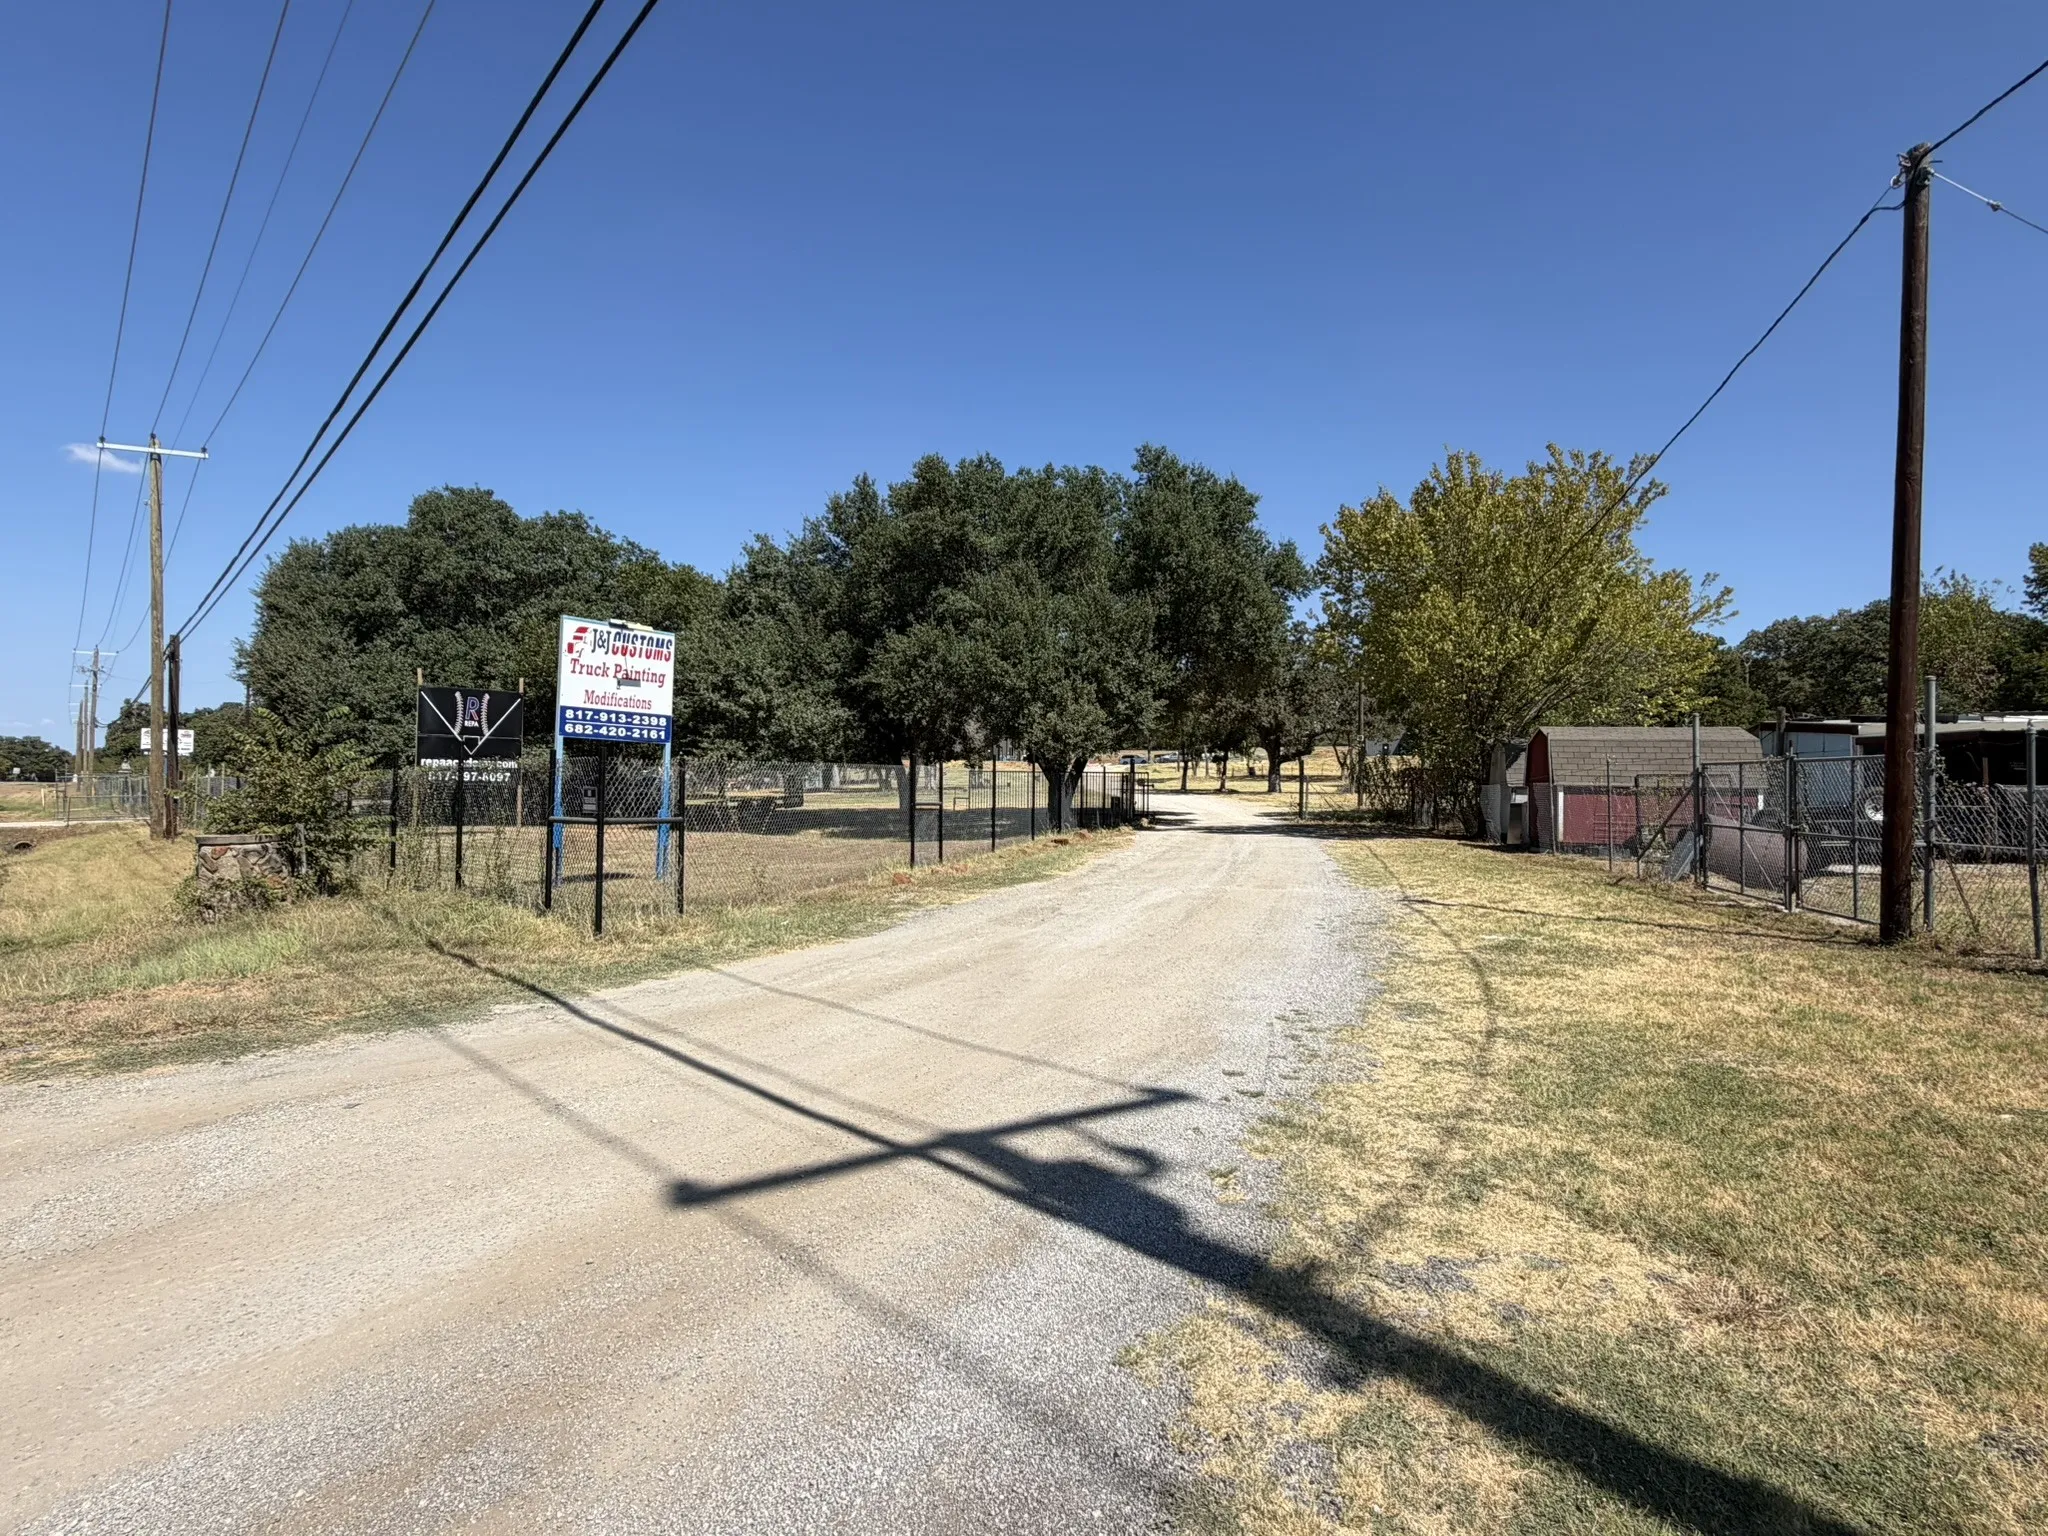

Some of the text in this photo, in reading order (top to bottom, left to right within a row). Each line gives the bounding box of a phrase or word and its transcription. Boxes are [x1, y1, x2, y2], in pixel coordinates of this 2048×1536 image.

[591, 628, 612, 655] J&J
[570, 658, 666, 688] Truck Painting
[583, 689, 652, 710] Modifications
[565, 709, 667, 726] 817-913-2398
[564, 723, 666, 739] 682-420-2161
